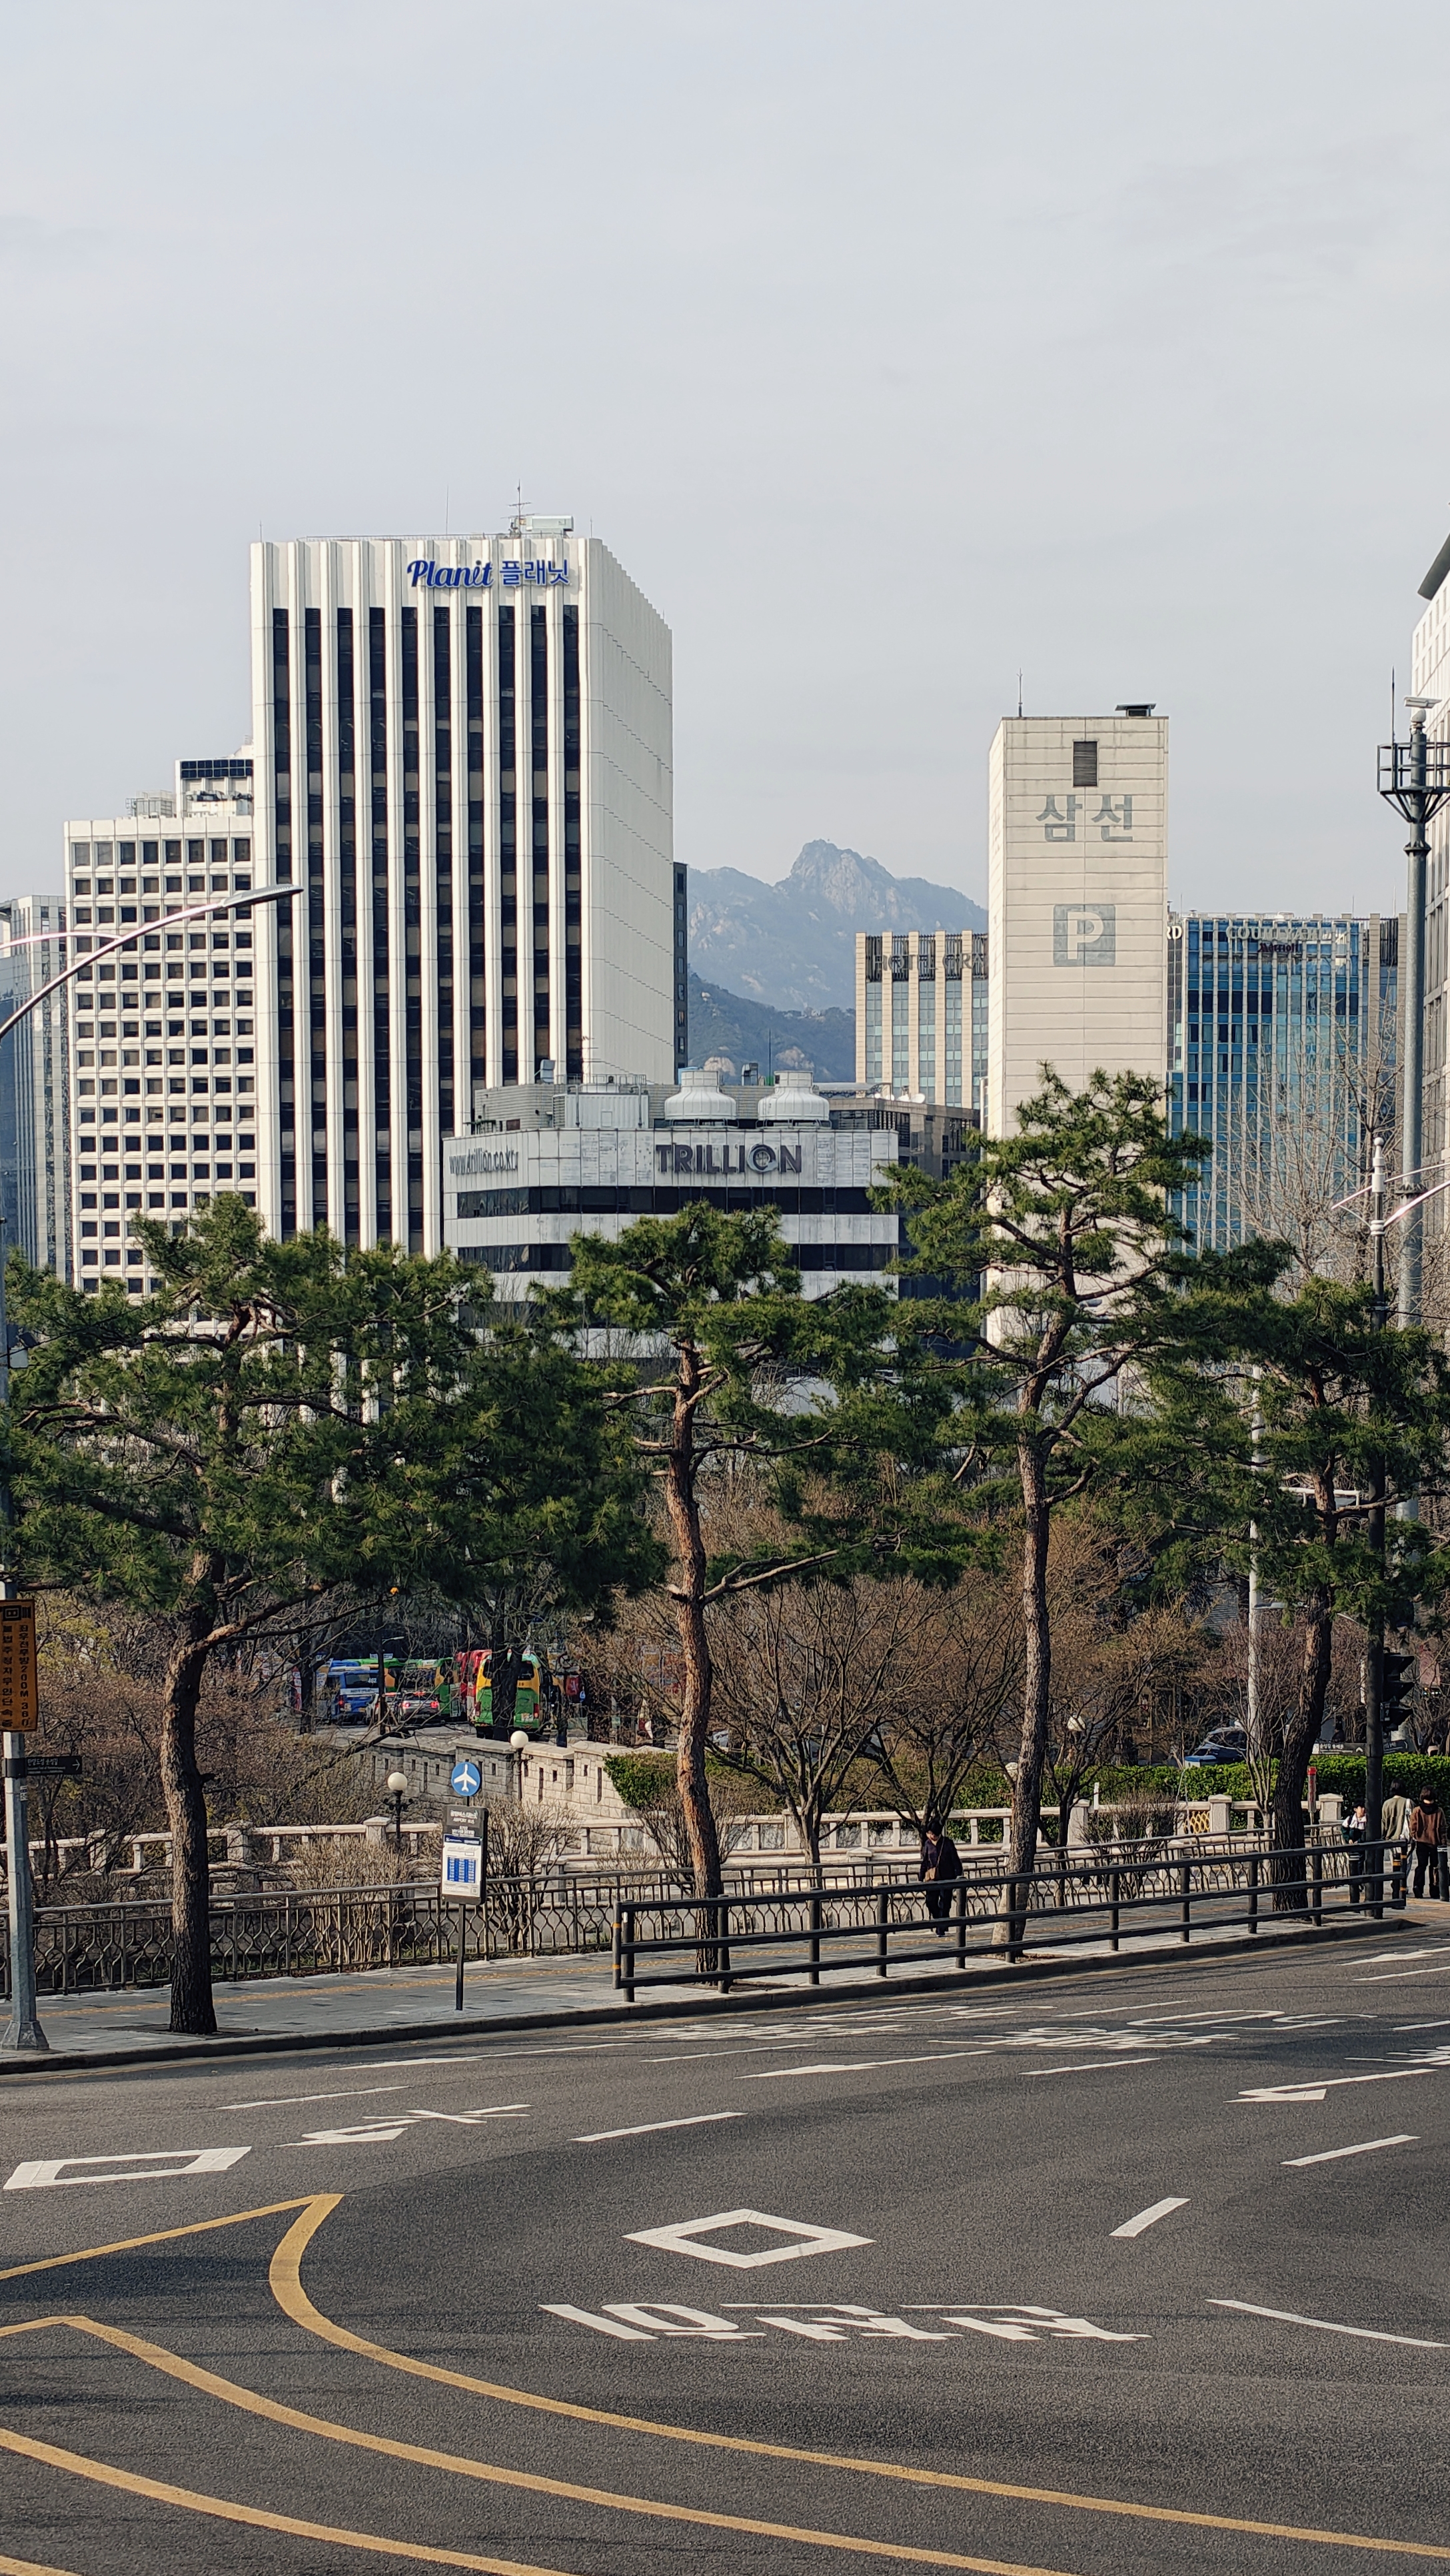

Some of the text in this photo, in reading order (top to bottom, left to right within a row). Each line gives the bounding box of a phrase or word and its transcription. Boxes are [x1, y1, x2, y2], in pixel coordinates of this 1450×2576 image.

[406, 558, 570, 588] Planit 플래닛
[1035, 794, 1133, 842] 삼선
[1066, 910, 1104, 960] P
[873, 954, 938, 971] HOTEL
[655, 1143, 802, 1173] TRILLION
